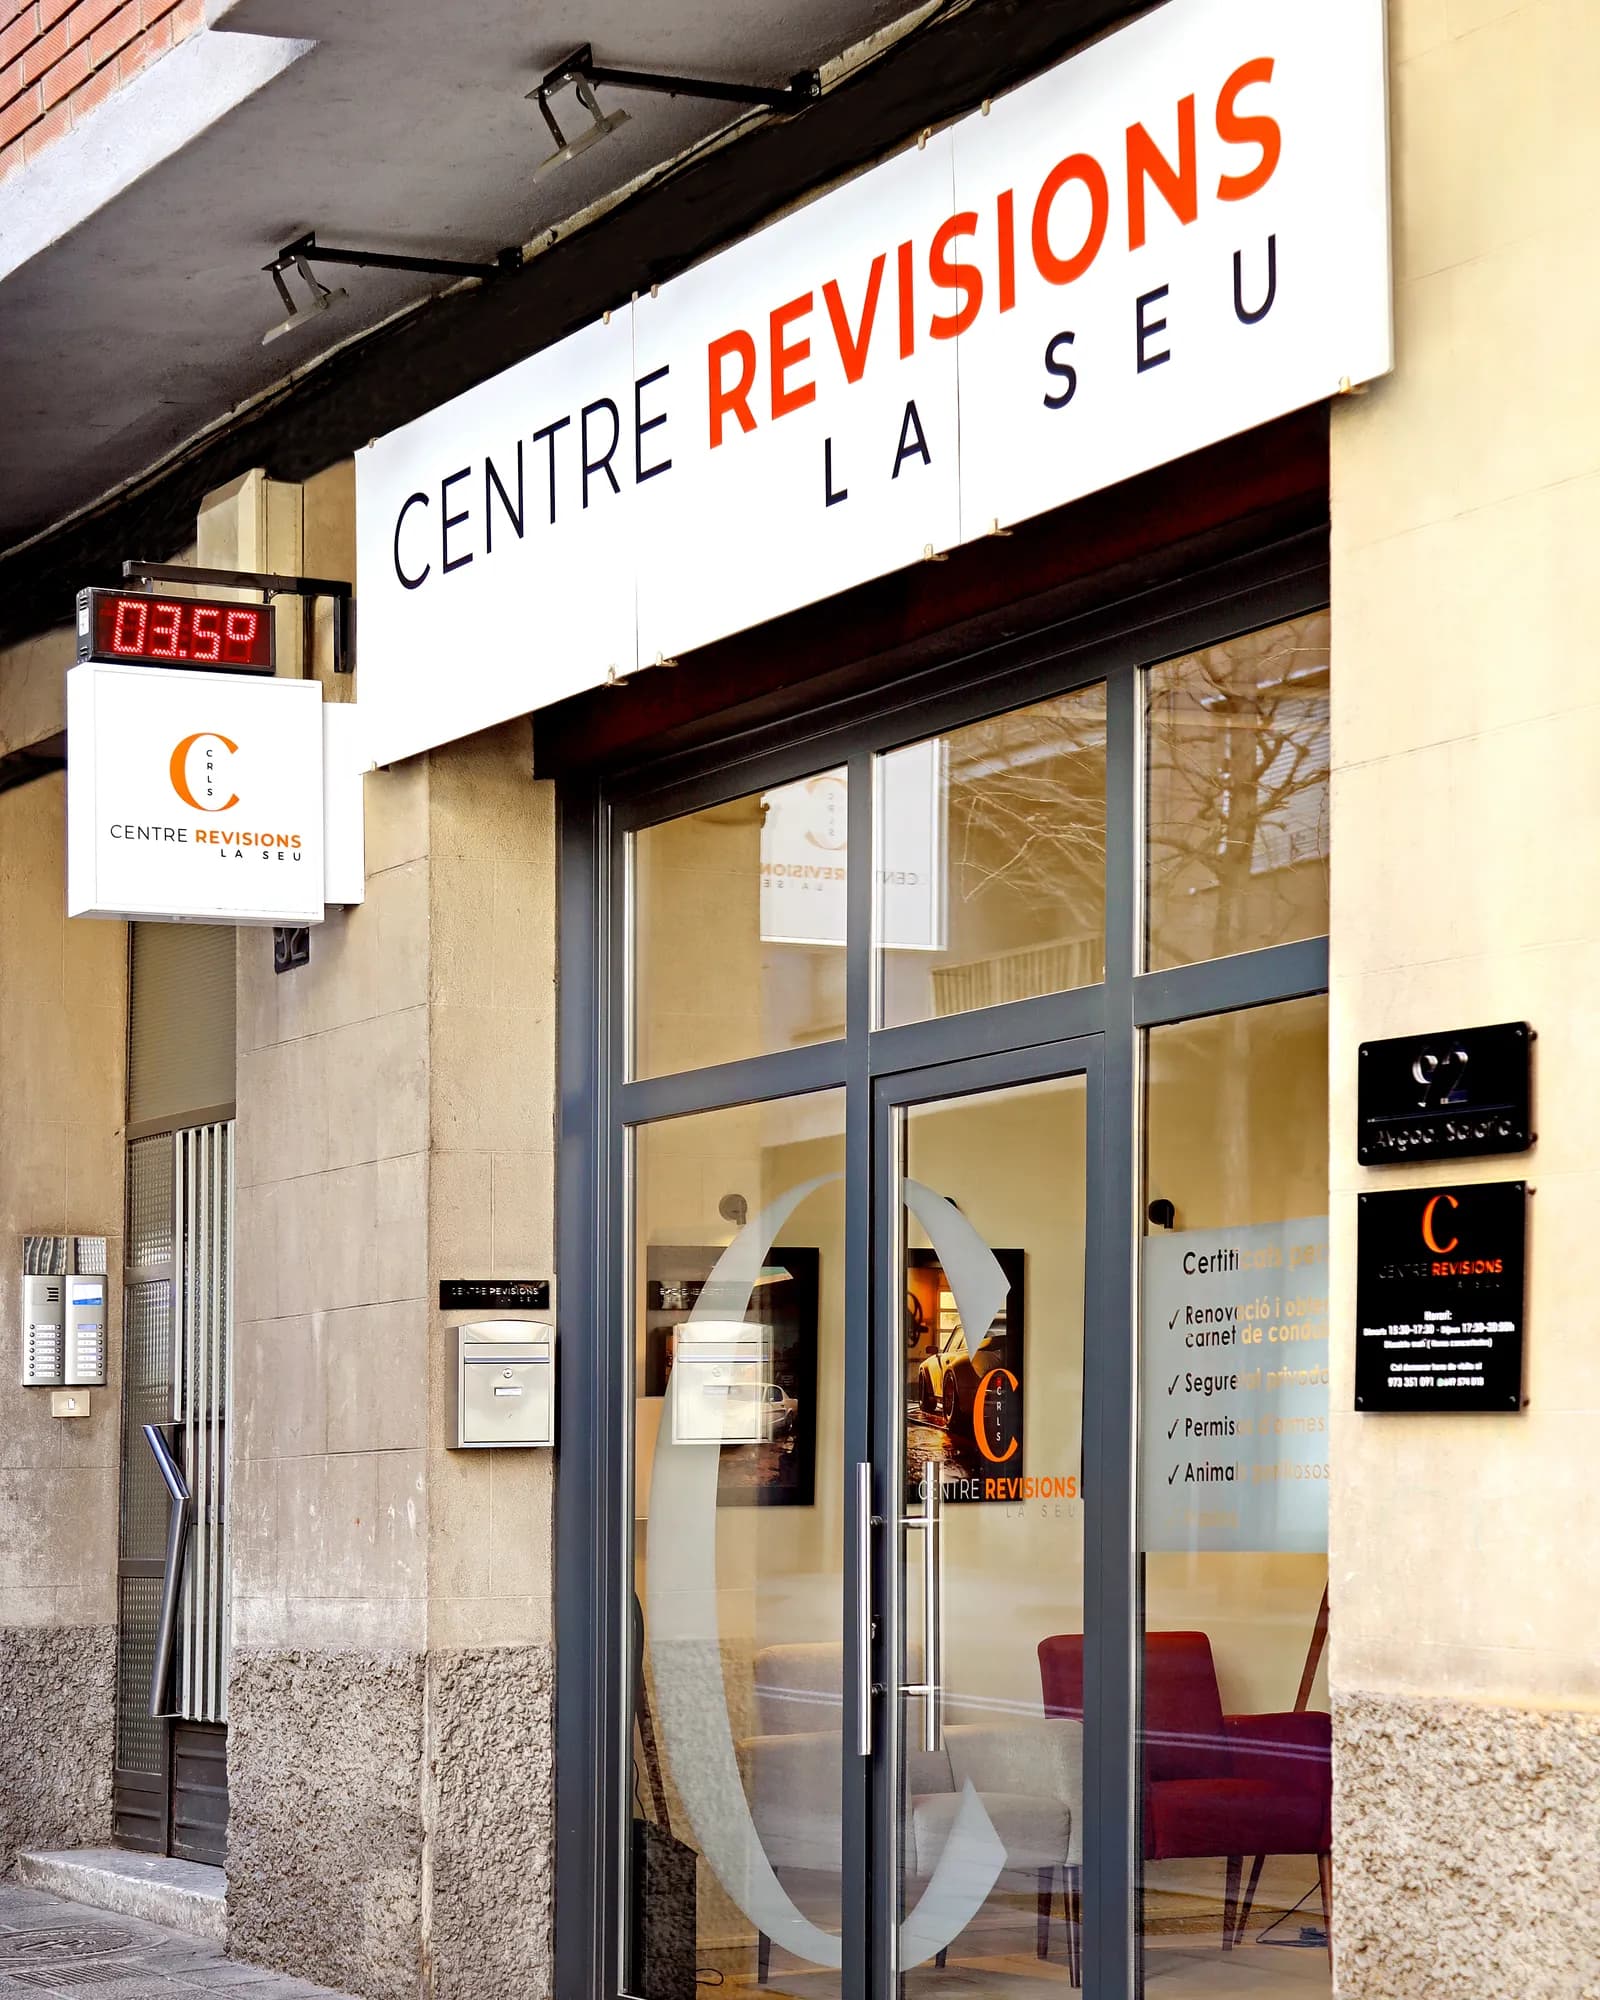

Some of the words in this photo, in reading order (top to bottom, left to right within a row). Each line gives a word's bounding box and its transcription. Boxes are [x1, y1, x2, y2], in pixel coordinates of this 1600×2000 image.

[394, 364, 672, 590] CENTRE
[707, 57, 1281, 449] REVISIONS
[823, 399, 931, 508] LA
[1042, 233, 1277, 410] SEU
[110, 824, 188, 843] CENTRE
[195, 829, 301, 848] REVISIONS
[220, 849, 243, 858] LA
[262, 851, 301, 861] SEU
[1431, 1259, 1503, 1276] REVISIONS
[1185, 1325, 1237, 1348] carnet
[918, 1478, 980, 1500] CENTRE
[985, 1476, 1077, 1500] REVISIONS
